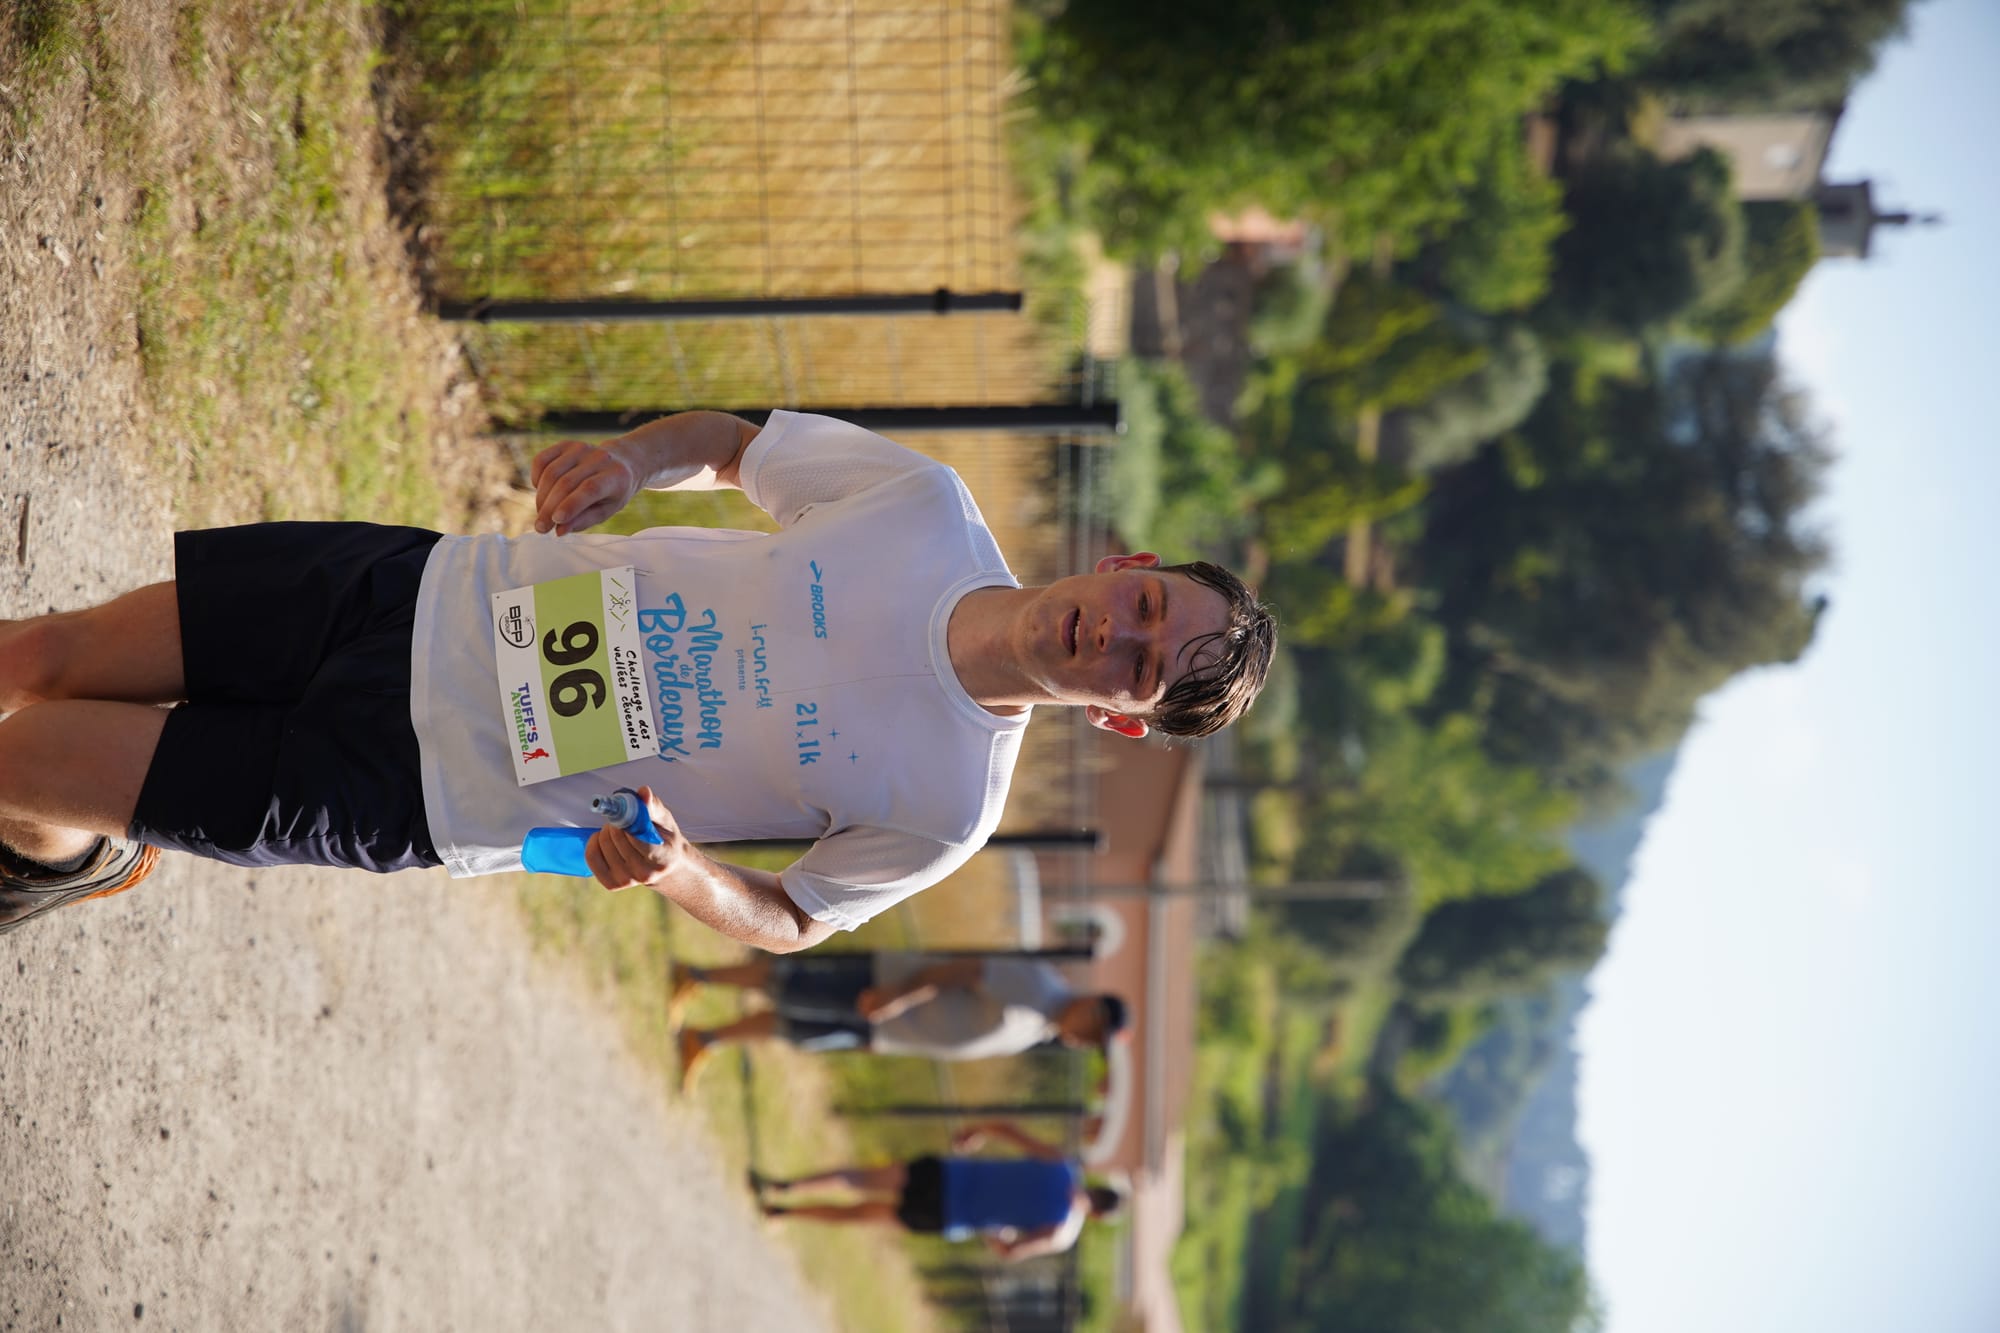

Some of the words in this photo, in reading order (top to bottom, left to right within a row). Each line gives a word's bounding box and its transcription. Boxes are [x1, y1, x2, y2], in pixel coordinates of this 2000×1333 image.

[509, 605, 523, 643] BFP
[810, 583, 828, 640] BROOKS
[542, 620, 607, 718] 96
[637, 591, 695, 763] Bordeaux
[679, 663, 694, 679] de
[686, 608, 727, 750] Marathon
[735, 648, 746, 691] présente
[751, 623, 771, 695] i-run.fr
[510, 690, 530, 752] Aventure
[518, 682, 539, 743] TUFF'S
[613, 646, 627, 689] vallées
[622, 695, 640, 750] cévenoles
[626, 650, 643, 712] Challenge
[638, 719, 651, 740] des
